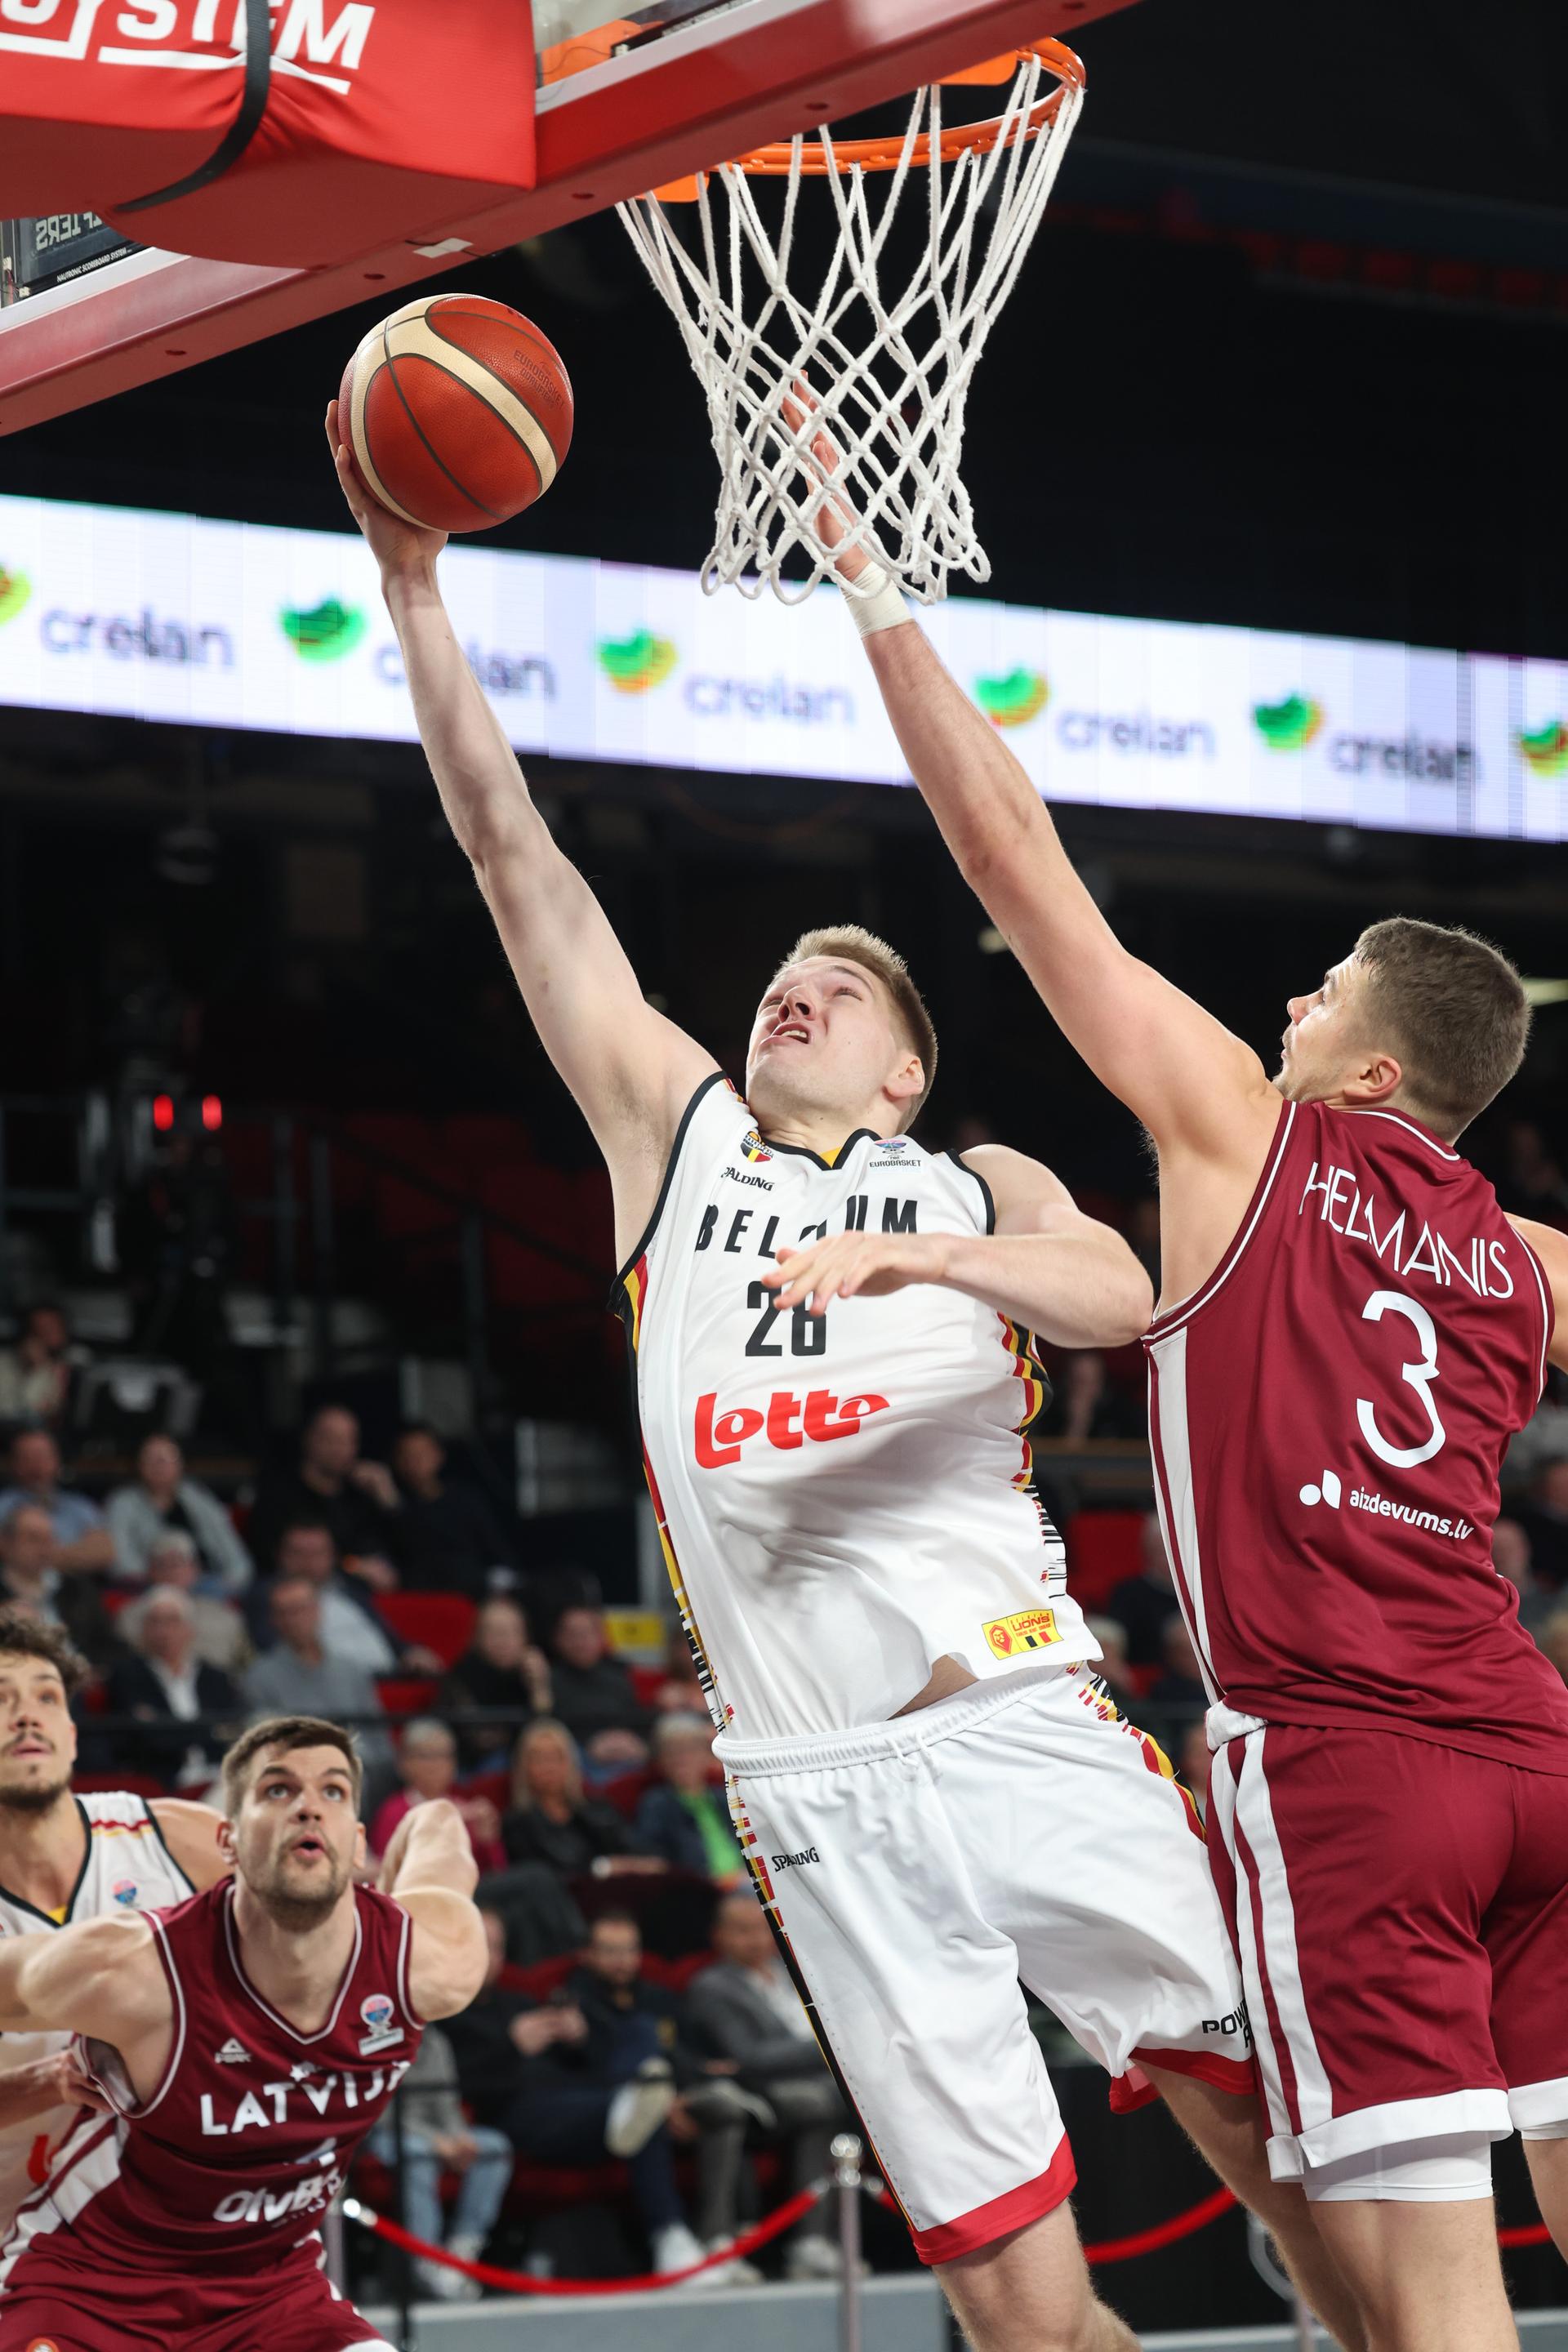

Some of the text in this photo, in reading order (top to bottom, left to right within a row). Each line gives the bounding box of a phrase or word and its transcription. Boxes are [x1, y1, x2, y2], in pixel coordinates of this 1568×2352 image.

[82, 254, 110, 273] SCOREBOARD
[41, 603, 236, 669] crelan
[684, 672, 858, 727] crelan
[1057, 701, 1217, 764] crelan
[869, 1159, 922, 1168] EUROBASKET
[695, 1195, 918, 1259] BELUM
[1298, 1161, 1515, 1299] HELMANIS
[745, 1281, 826, 1356] 28
[1356, 1290, 1446, 1469] 3
[1349, 1486, 1475, 1541] aizdevums.lv
